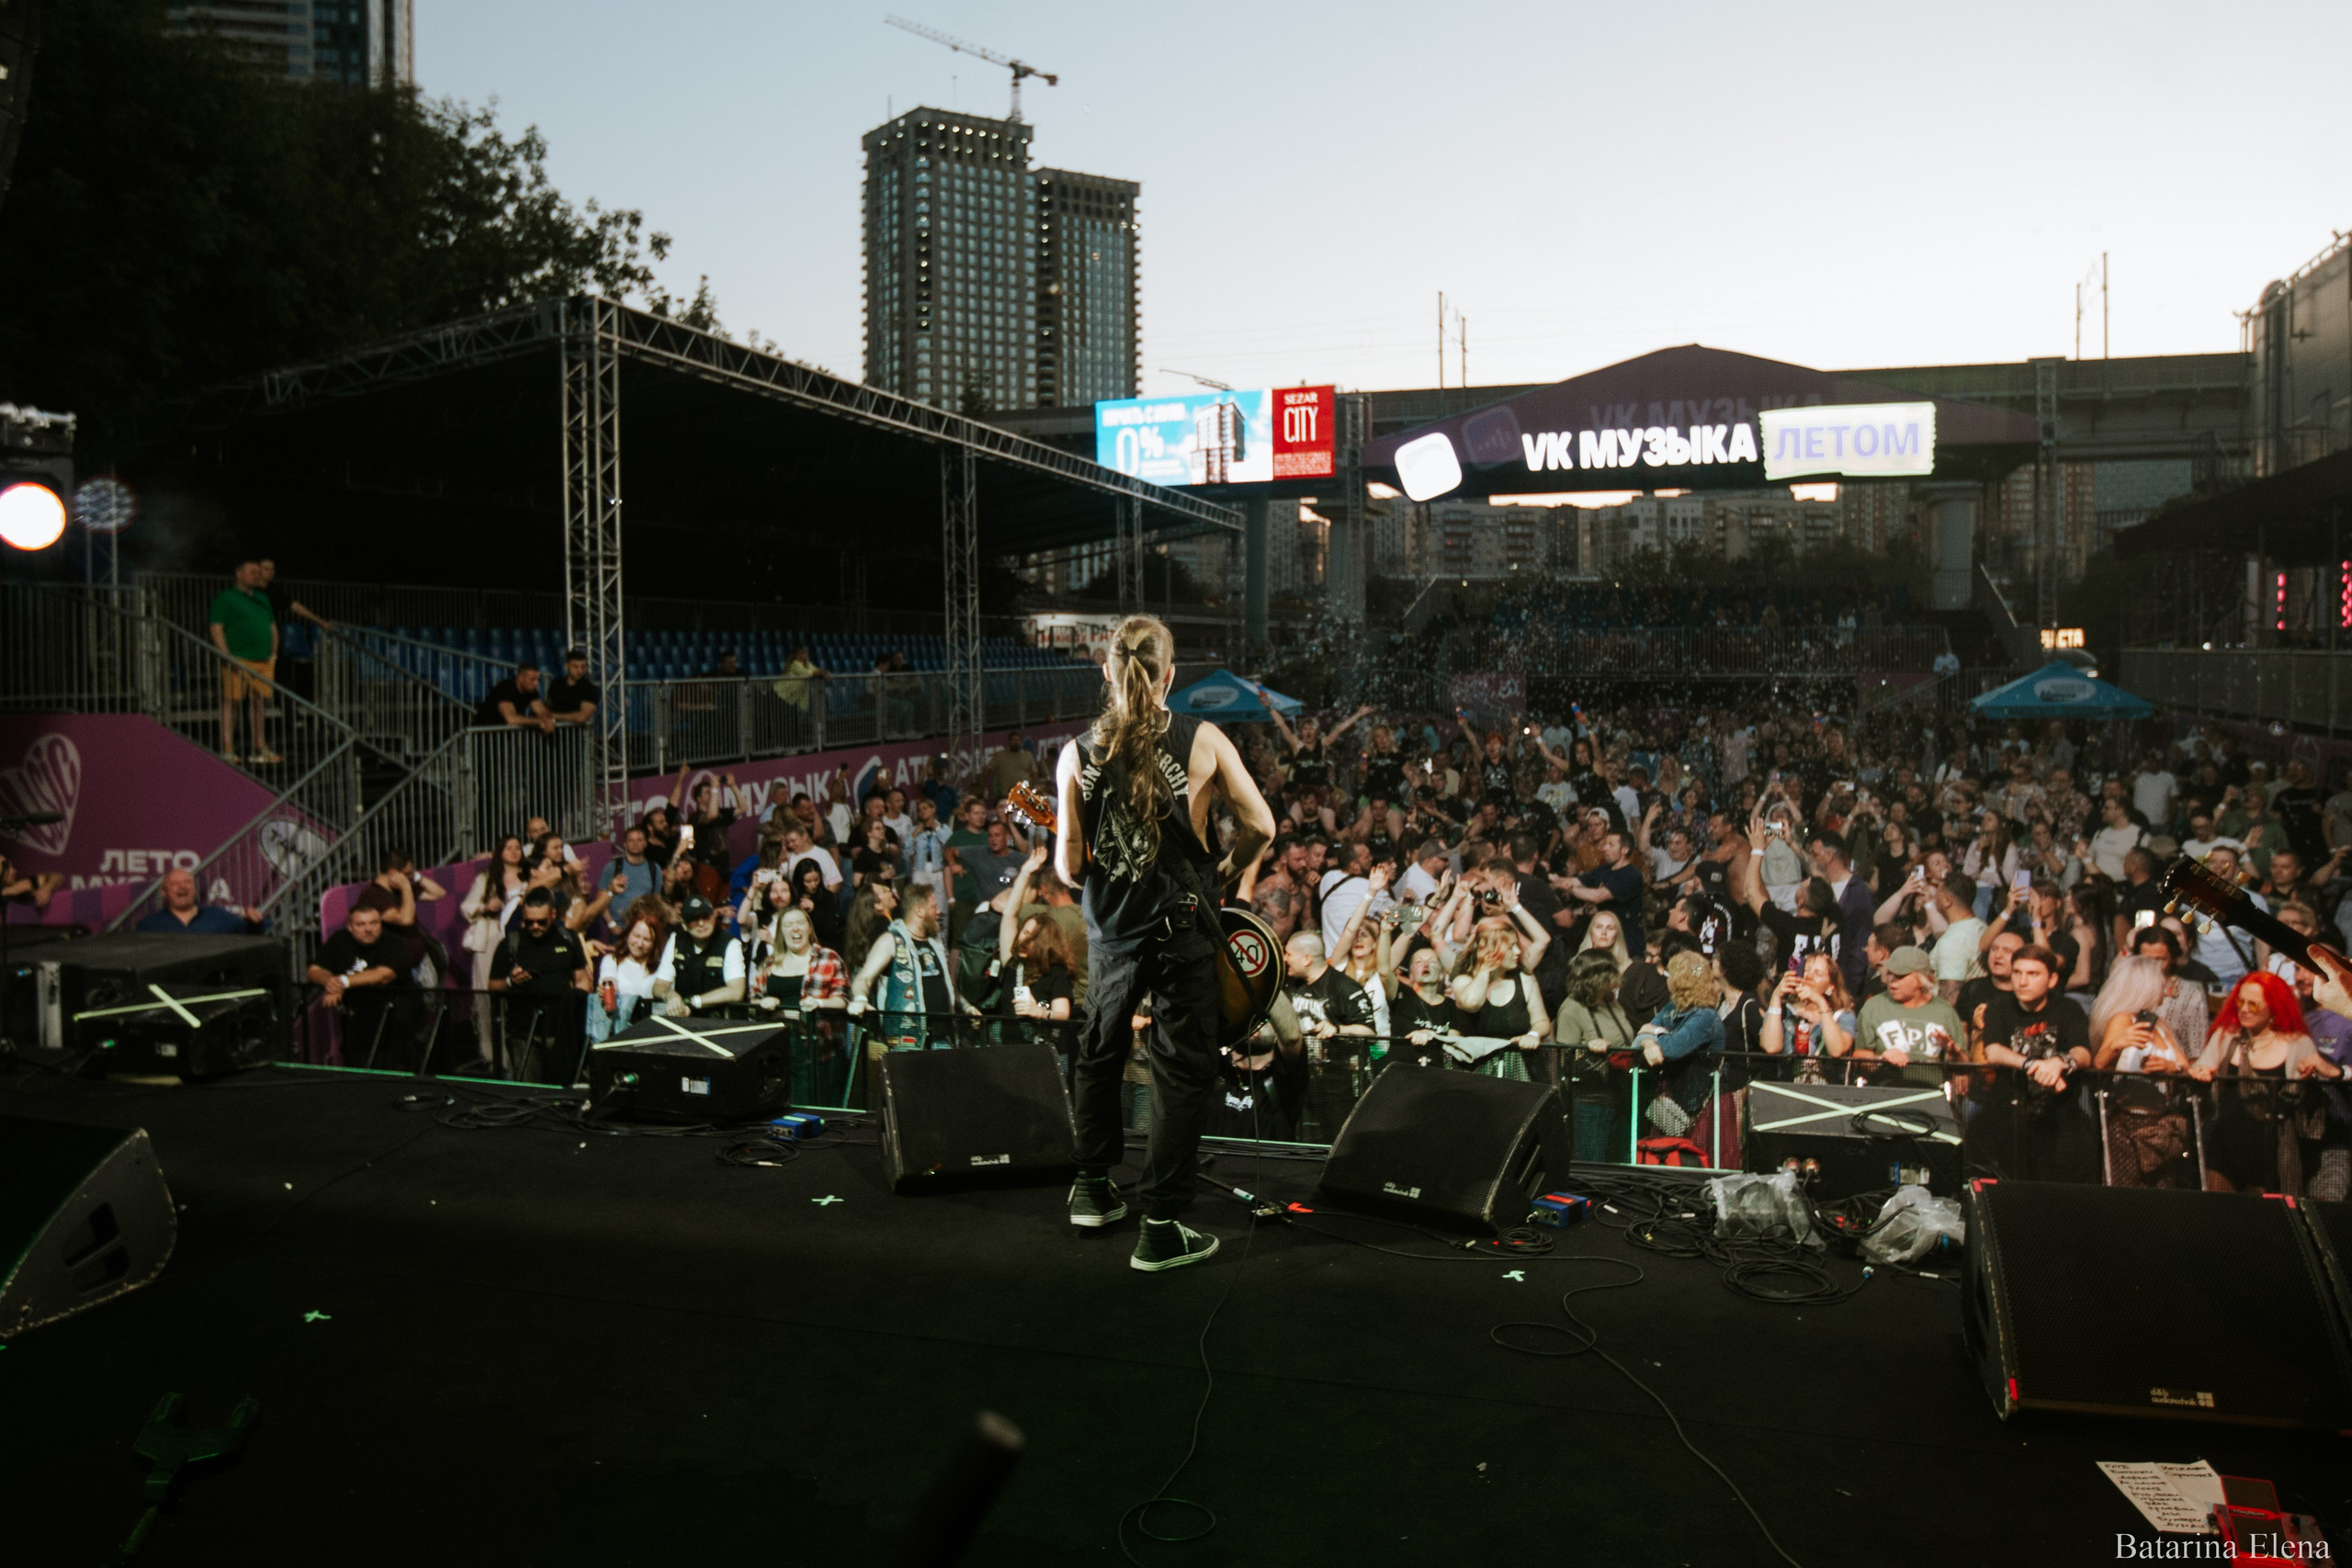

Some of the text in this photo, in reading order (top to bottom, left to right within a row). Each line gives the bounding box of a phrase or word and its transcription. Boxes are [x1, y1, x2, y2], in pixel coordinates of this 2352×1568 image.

[1283, 392, 1318, 405] SEZAR
[1283, 406, 1318, 444] CITY
[1521, 422, 1920, 472] VK МУЗЫКА ЛЕТОМ
[100, 850, 202, 874] ЛЕТО
